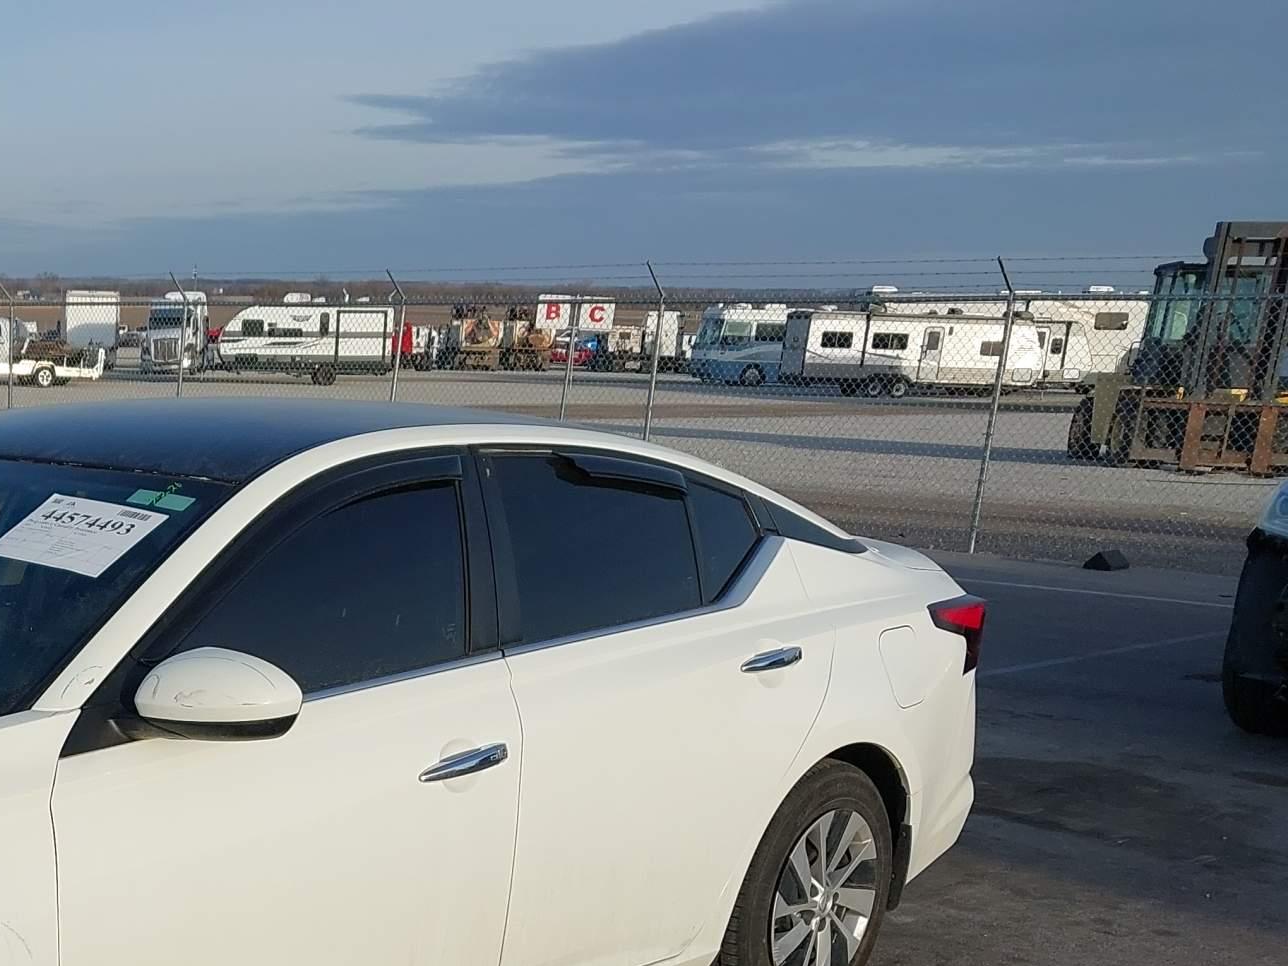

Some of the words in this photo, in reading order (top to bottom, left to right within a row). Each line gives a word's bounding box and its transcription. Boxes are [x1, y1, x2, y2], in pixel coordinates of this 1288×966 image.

[545, 303, 561, 320] B
[588, 306, 605, 323] C
[41, 509, 136, 535] 44574493
